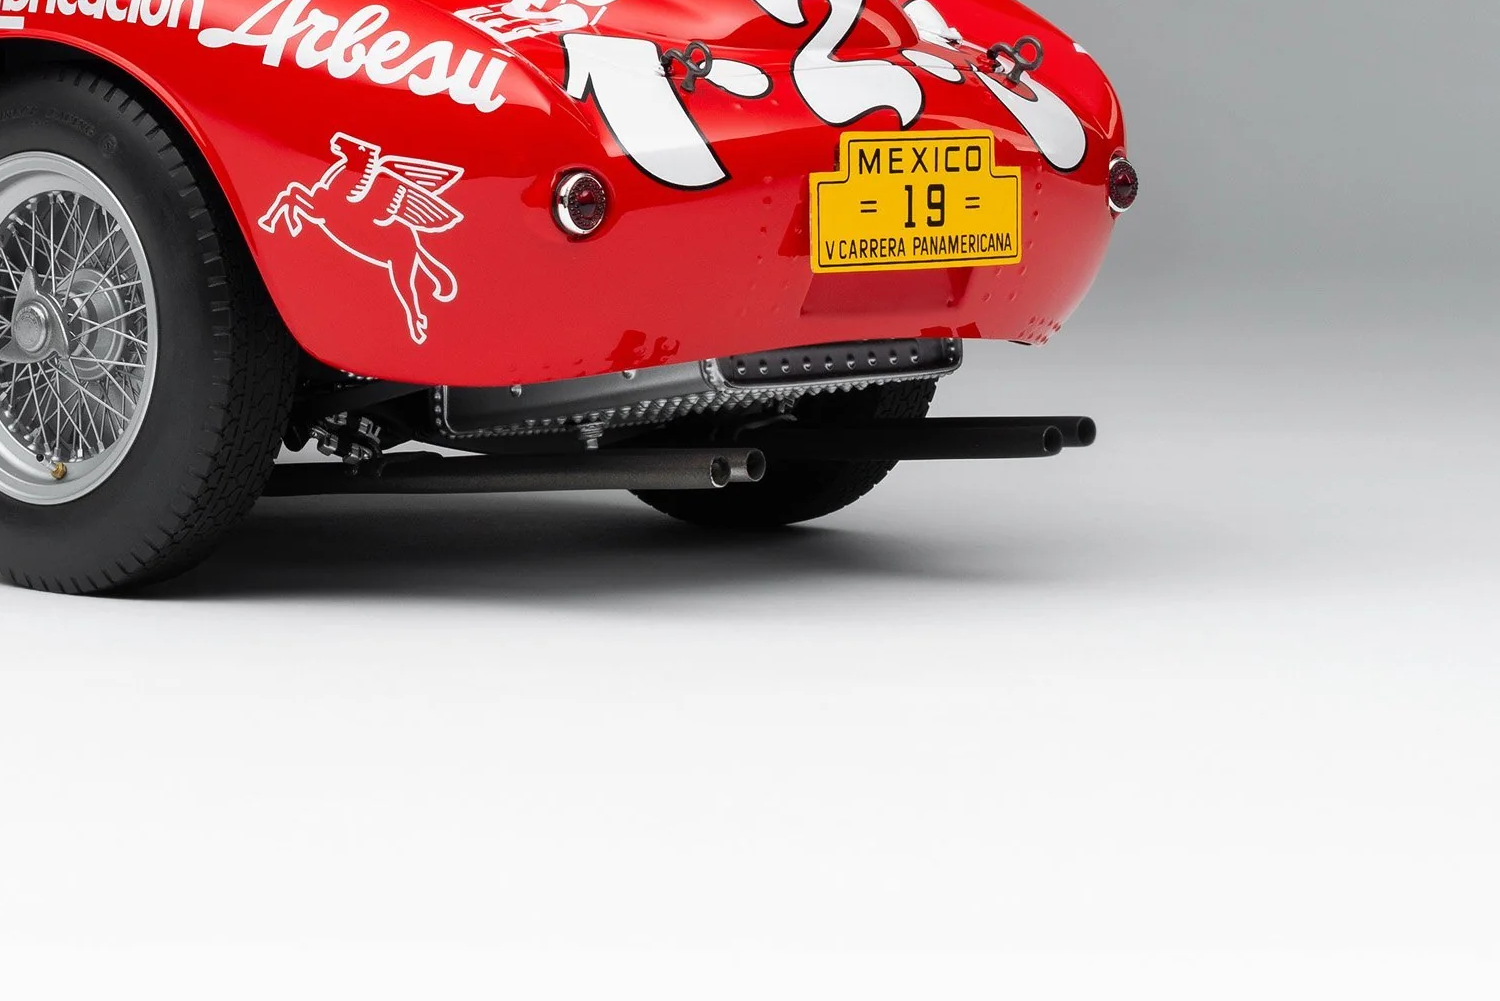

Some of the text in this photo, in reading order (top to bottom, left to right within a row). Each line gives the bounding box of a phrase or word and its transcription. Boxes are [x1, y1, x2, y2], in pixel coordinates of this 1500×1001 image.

[858, 145, 982, 175] MEXICO
[904, 183, 946, 229] 19
[825, 232, 1013, 261] V CARRERA PANAMERICANA
